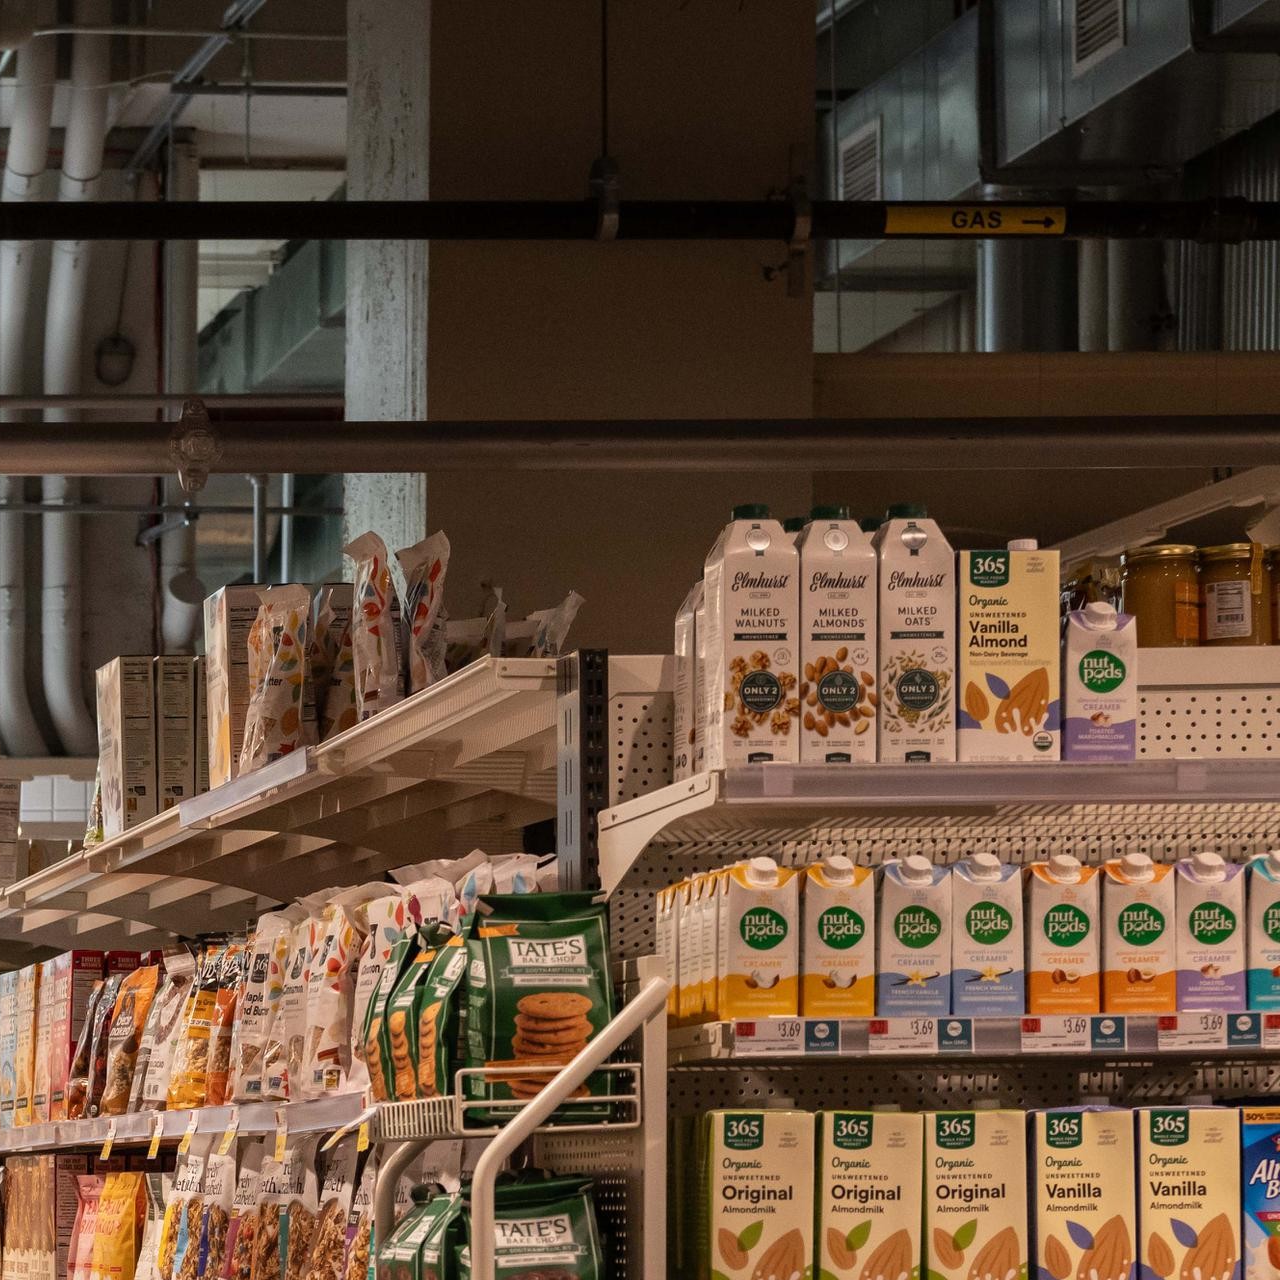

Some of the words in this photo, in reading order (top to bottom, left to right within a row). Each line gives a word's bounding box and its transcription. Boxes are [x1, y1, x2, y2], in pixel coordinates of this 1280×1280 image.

[952, 211, 1001, 228] GAS
[974, 557, 1005, 574] 365
[732, 572, 790, 592] Elmhurst
[810, 572, 869, 592] Elmhurst
[888, 570, 947, 591] Elmhurst
[969, 595, 1008, 608] Organic
[741, 608, 779, 616] MILKED
[819, 608, 858, 617] MILKED
[898, 607, 937, 615] MILKED
[736, 619, 786, 627] WALNUTS
[813, 619, 865, 627] ALMONDS
[905, 617, 930, 626] OATS
[969, 621, 1018, 633] Vanilla
[969, 635, 1027, 647] Almond
[1084, 655, 1108, 668] nut
[1084, 664, 1122, 684] pods
[901, 685, 927, 693] ONLY
[745, 913, 770, 925] nut
[823, 912, 849, 924] nut
[899, 911, 925, 923] nut
[970, 907, 995, 920] nut
[746, 923, 784, 941] pods
[824, 922, 861, 941] pods
[899, 921, 937, 939] pods
[971, 917, 1009, 936] pods
[512, 939, 581, 957] TATE'S
[778, 1021, 800, 1037] $3.69
[911, 1020, 933, 1035] $3.69
[1200, 1016, 1223, 1030] $3.69
[728, 1120, 760, 1136] 365
[837, 1119, 868, 1136] 365
[1050, 1119, 1078, 1135] 365
[1154, 1117, 1185, 1133] 365
[722, 1158, 762, 1172] Organic
[832, 1158, 870, 1171] Organic
[1149, 1154, 1188, 1168] Organic
[722, 1185, 792, 1203] Original
[832, 1185, 900, 1203] Original
[936, 1184, 1005, 1202] Original
[1046, 1183, 1101, 1198] Vanilla
[1150, 1181, 1206, 1196] Vanilla
[722, 1205, 776, 1214] Almondmilk
[832, 1204, 884, 1214] Almondmilk
[1150, 1201, 1202, 1210] Almondmilk
[496, 1219, 566, 1236] TATE'S
